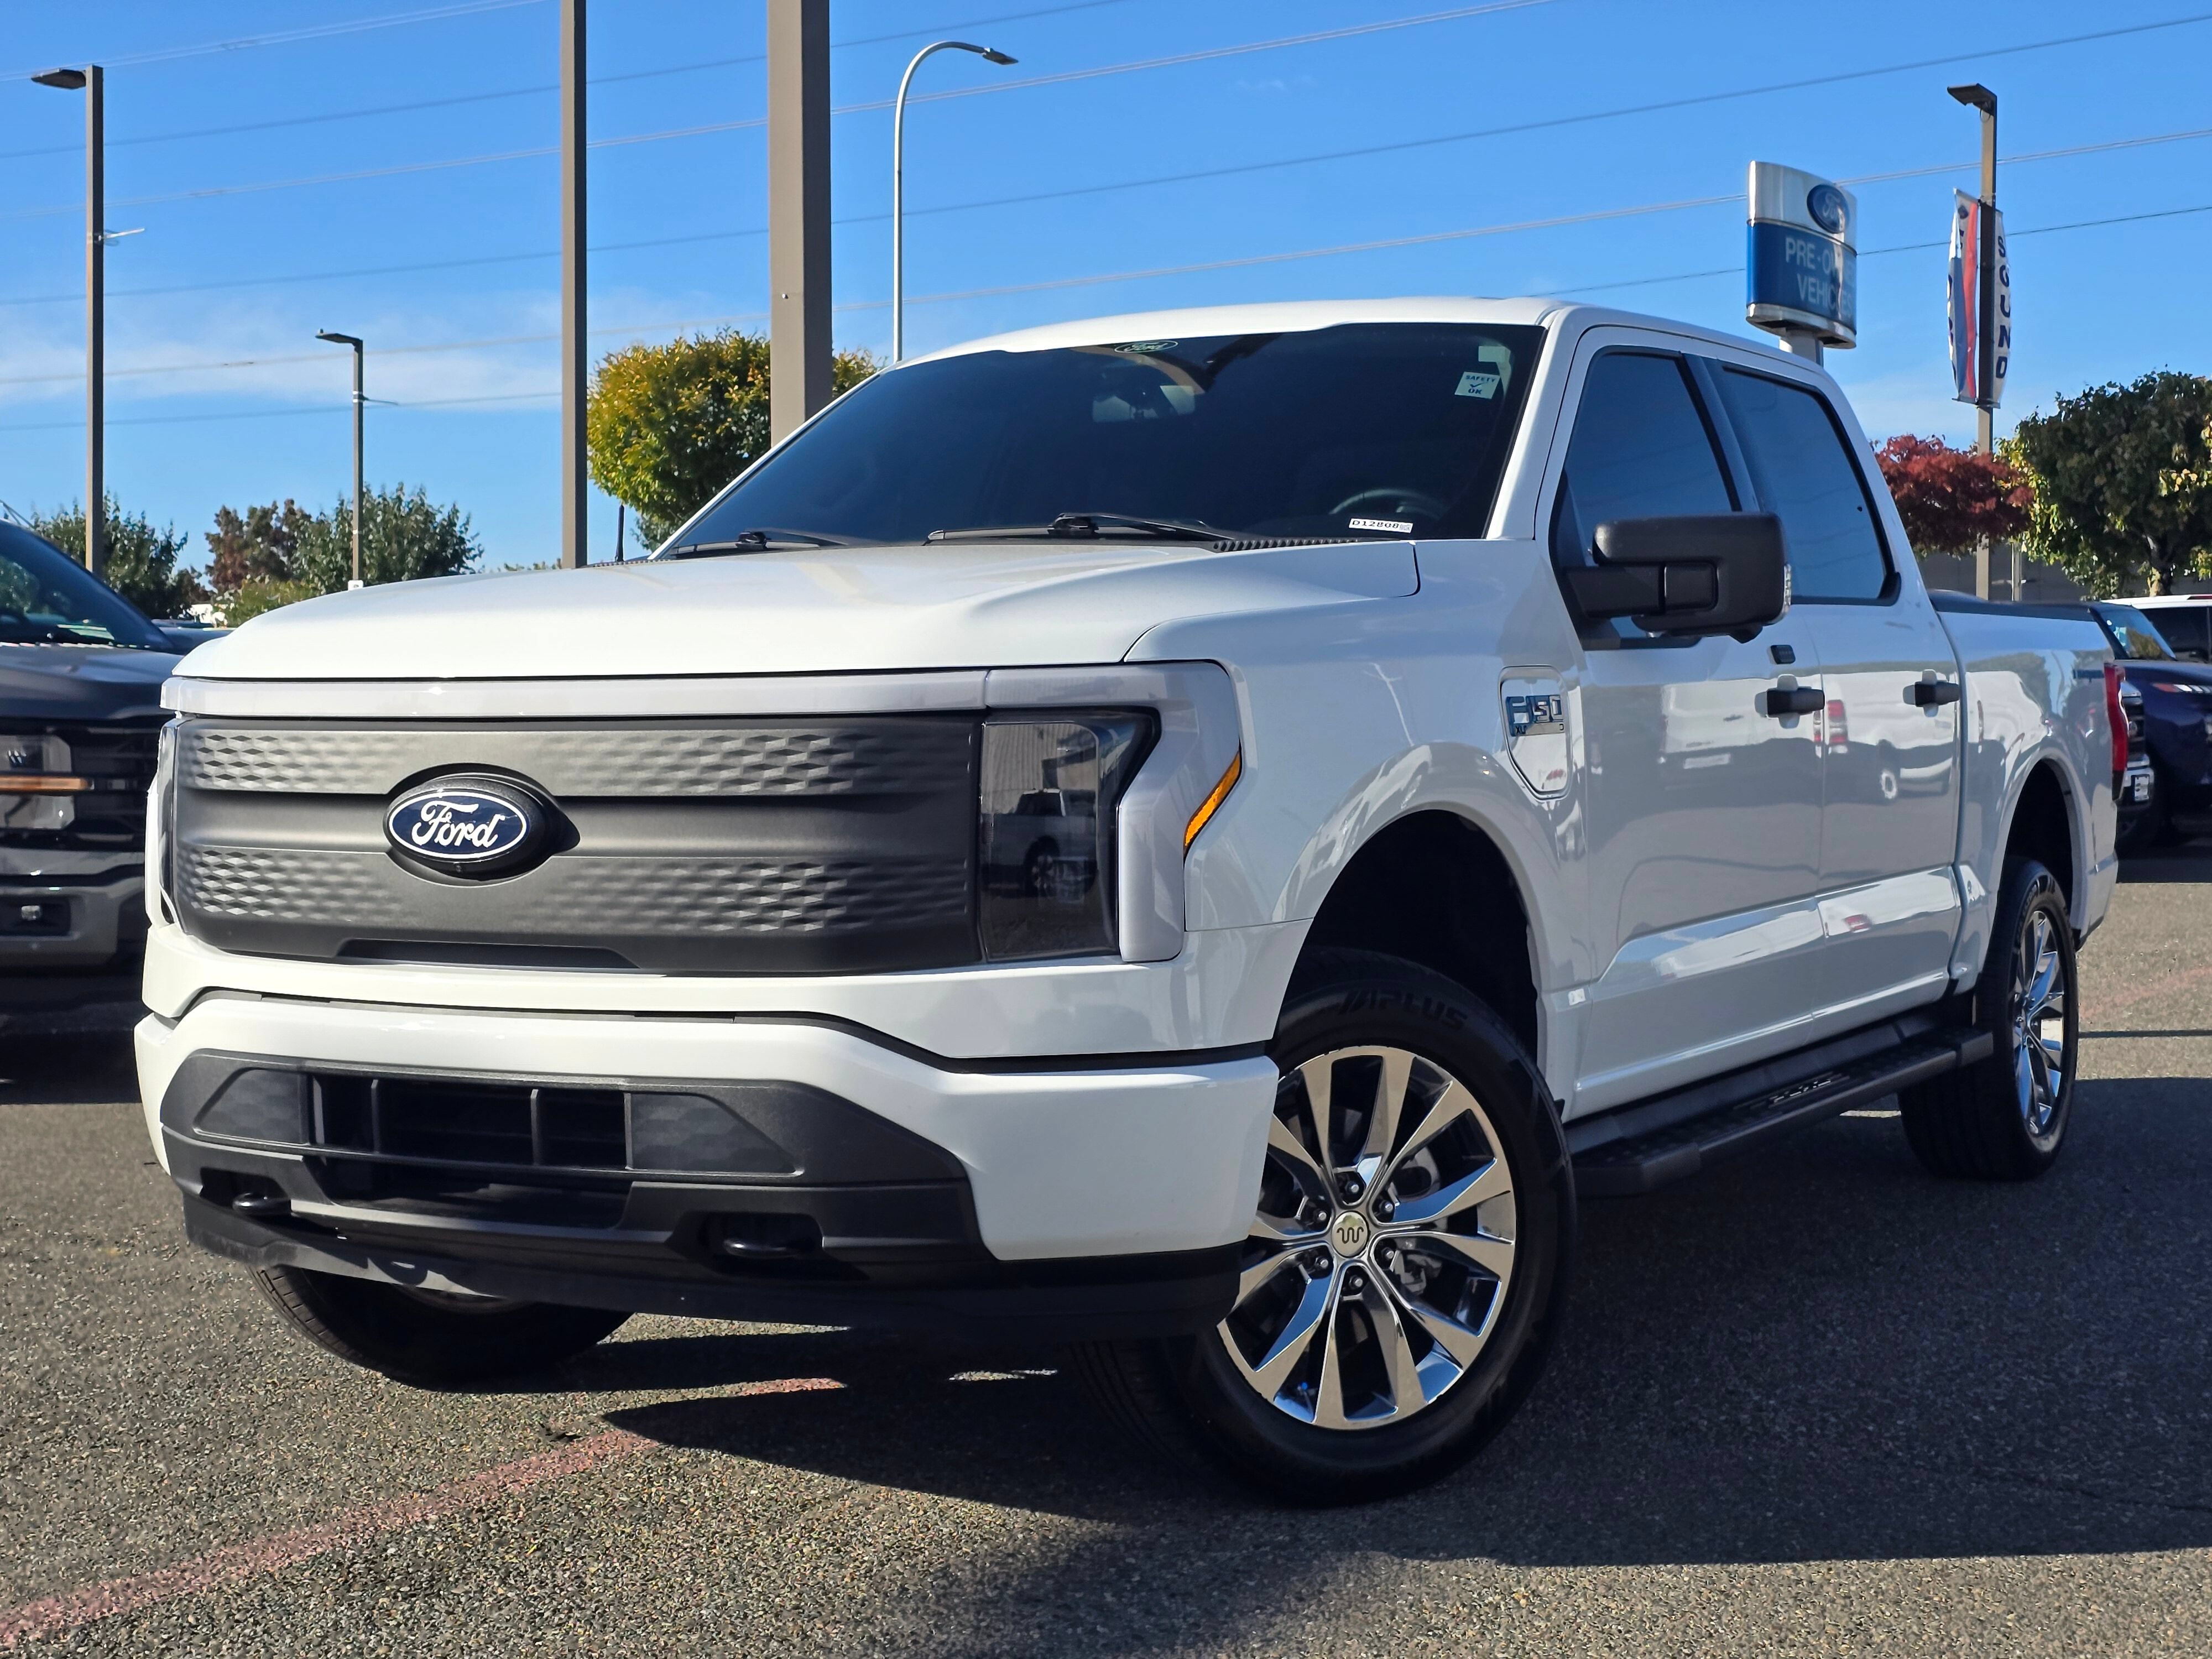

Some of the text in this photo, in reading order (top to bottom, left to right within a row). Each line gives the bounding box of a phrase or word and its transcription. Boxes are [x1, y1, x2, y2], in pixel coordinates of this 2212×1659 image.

[1785, 237, 1855, 290] PRE-OED
[1797, 273, 1853, 319] VEHICES
[1124, 342, 1168, 352] Ford
[411, 800, 505, 848] Ford
